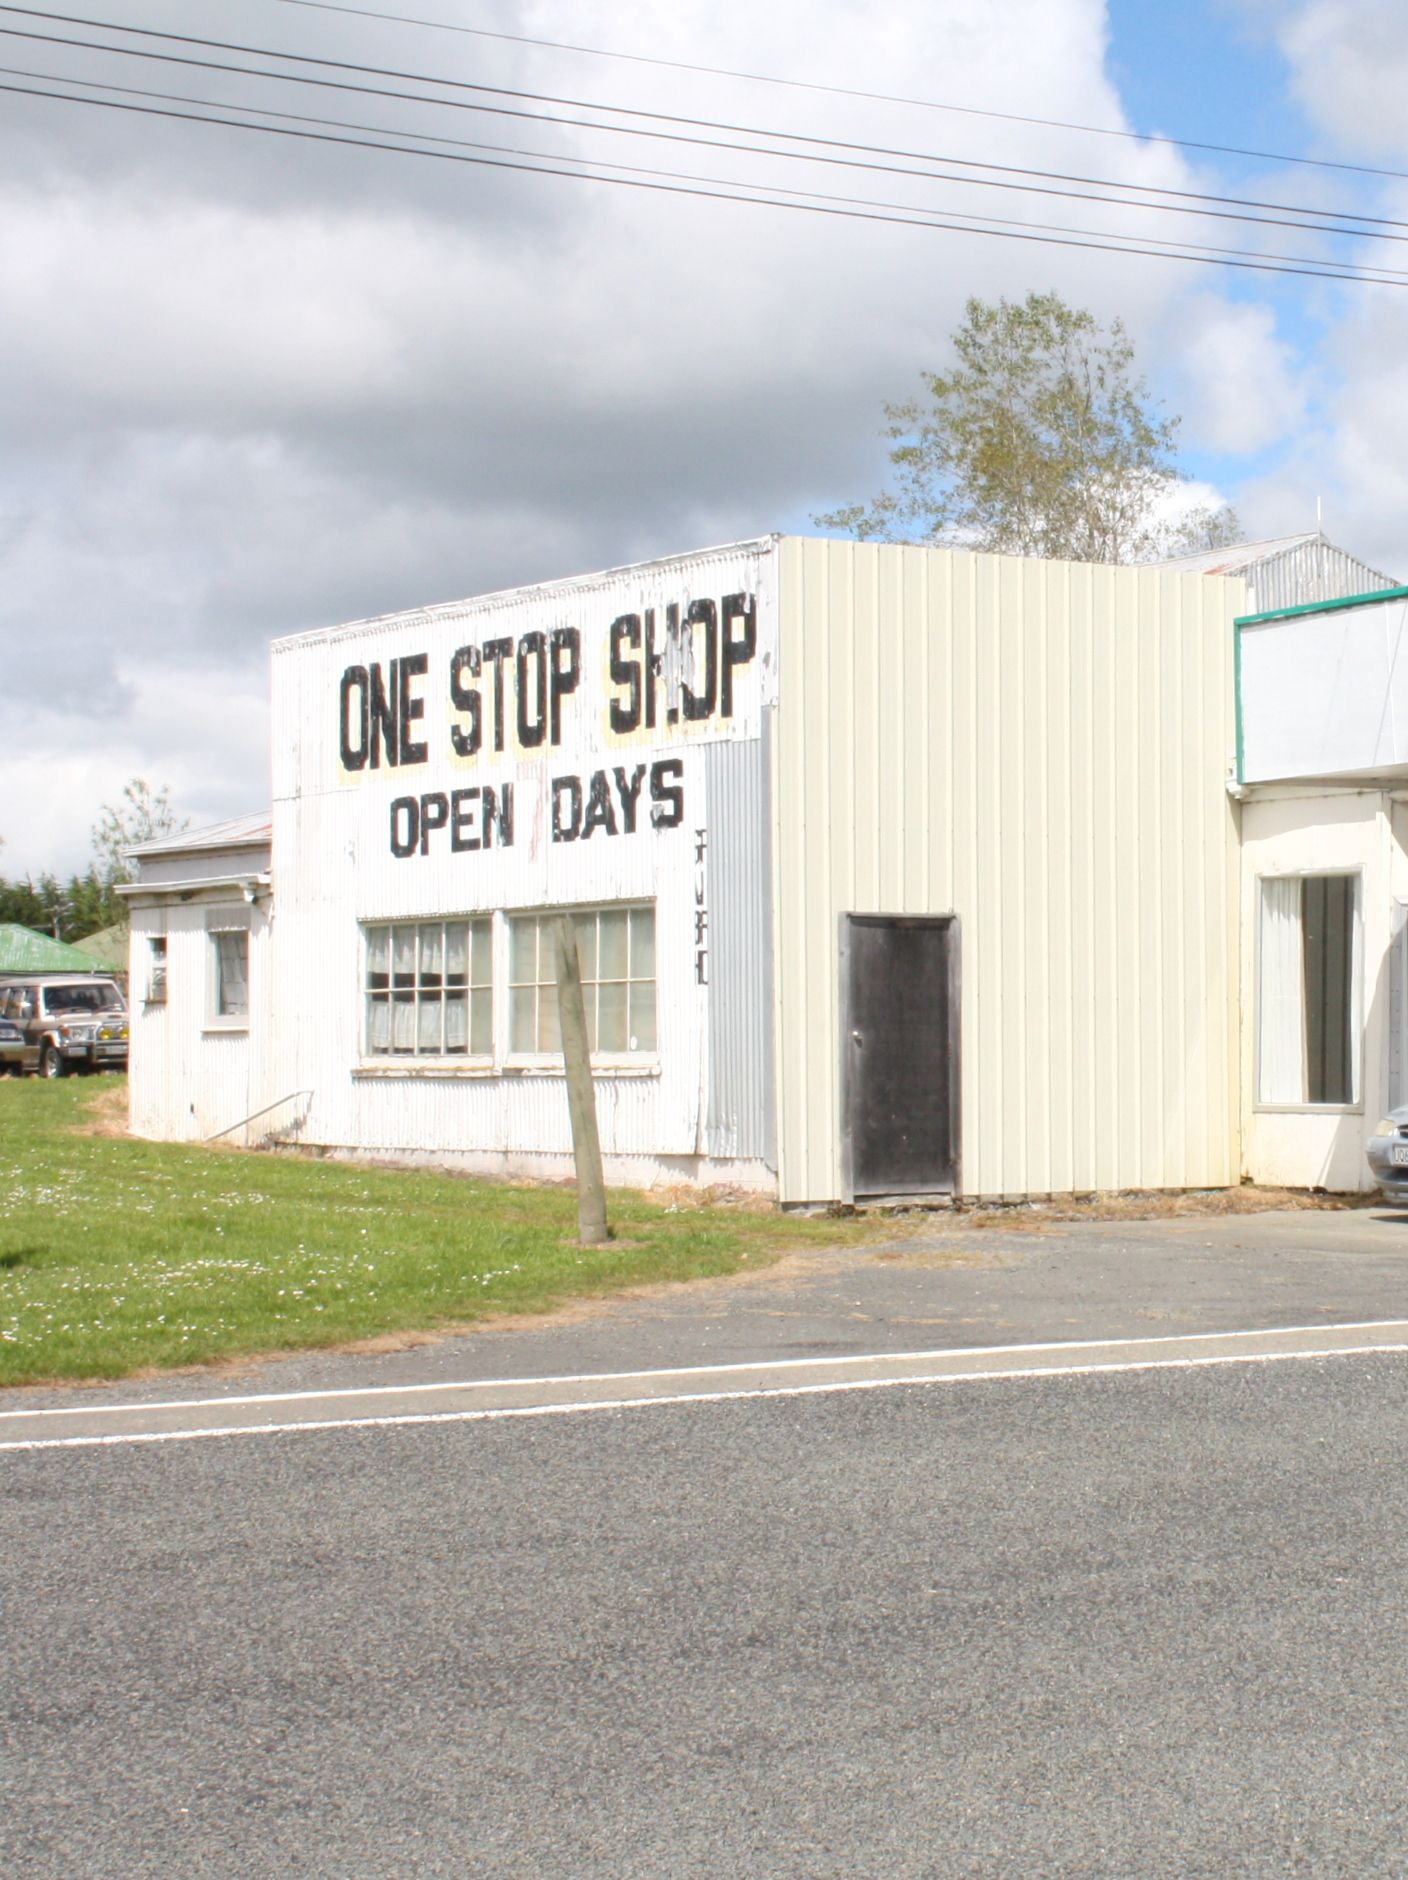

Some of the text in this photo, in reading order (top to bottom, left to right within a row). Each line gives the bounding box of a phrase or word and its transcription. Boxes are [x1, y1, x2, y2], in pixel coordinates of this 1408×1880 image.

[339, 592, 758, 772] ONE STOP SHOP
[390, 781, 515, 859] OPEN
[551, 758, 684, 844] DAYS
